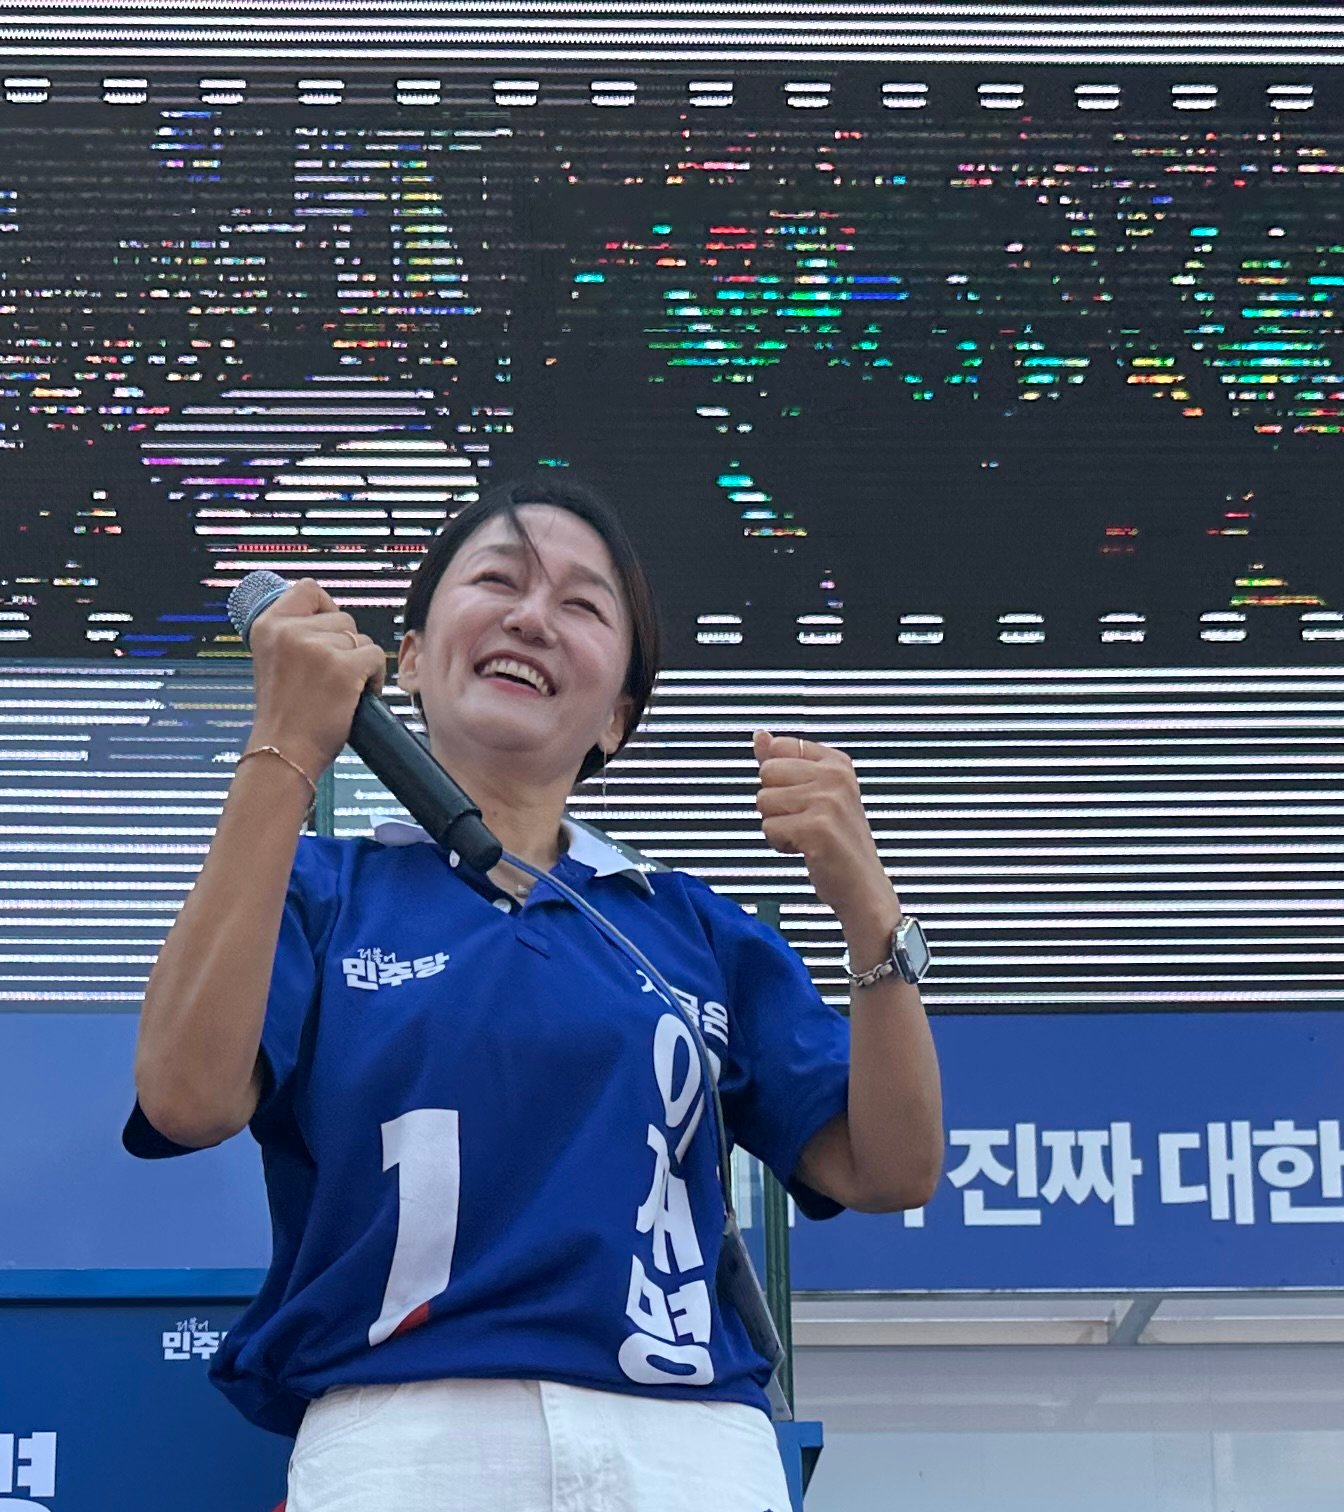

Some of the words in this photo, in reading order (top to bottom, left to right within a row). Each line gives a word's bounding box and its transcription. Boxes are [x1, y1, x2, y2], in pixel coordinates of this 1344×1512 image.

[342, 952, 450, 990] 민주당
[946, 1121, 1143, 1226] 진짜
[369, 1108, 460, 1346] 1
[162, 1331, 228, 1361] 민주
